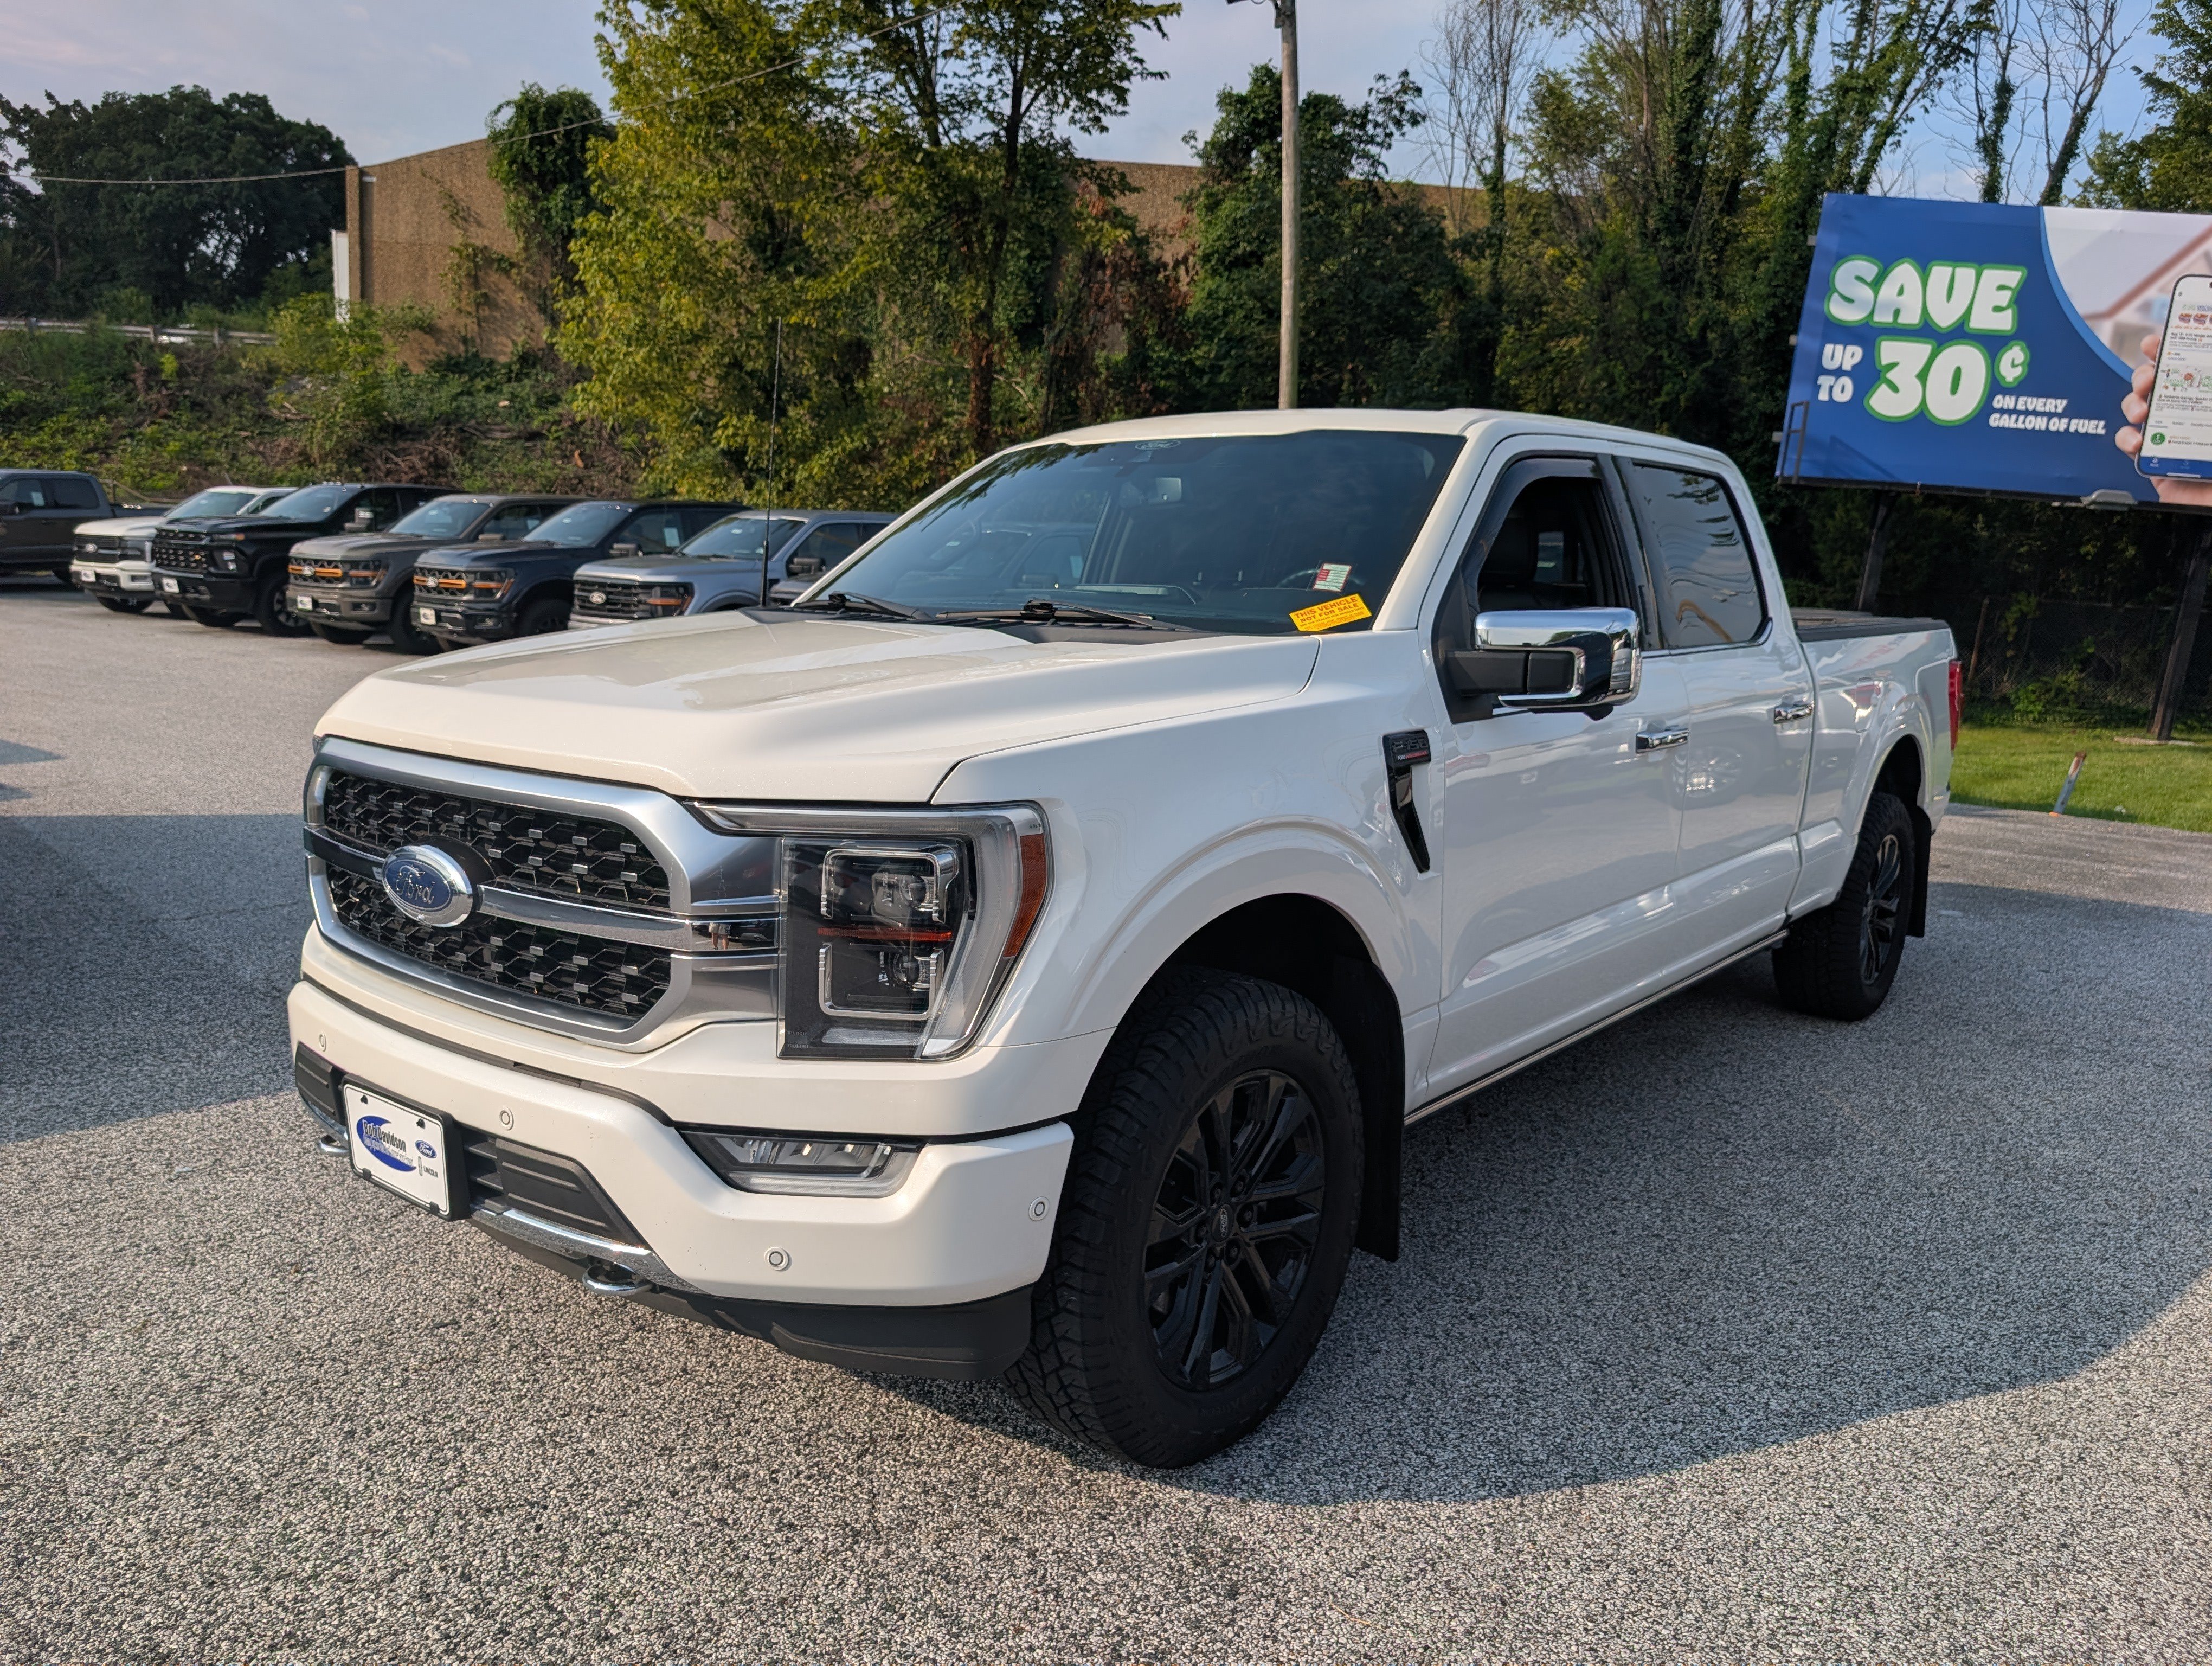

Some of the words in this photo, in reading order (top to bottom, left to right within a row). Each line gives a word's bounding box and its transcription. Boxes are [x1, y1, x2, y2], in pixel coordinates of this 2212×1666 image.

[1826, 257, 2025, 332] SAVE
[1822, 343, 1863, 372] UP
[1817, 375, 1854, 403] TO
[1992, 394, 2016, 410] ON
[2016, 395, 2068, 413] EVERY
[1989, 412, 2048, 431] GALLON
[2048, 416, 2069, 432] OF
[2068, 418, 2106, 435] FUEL
[1294, 608, 1316, 619] THIS
[1317, 596, 1358, 612] VEHICLE
[1300, 614, 1317, 623] NOT
[1318, 609, 1336, 617] FOR
[1337, 603, 1359, 612] SALE
[1392, 738, 1428, 753] F-150
[396, 864, 435, 904] Ford
[363, 1120, 377, 1137] Bob
[376, 1125, 407, 1153] Davidson
[419, 1142, 434, 1156] Ford
[423, 1165, 439, 1178] LINCOLN
